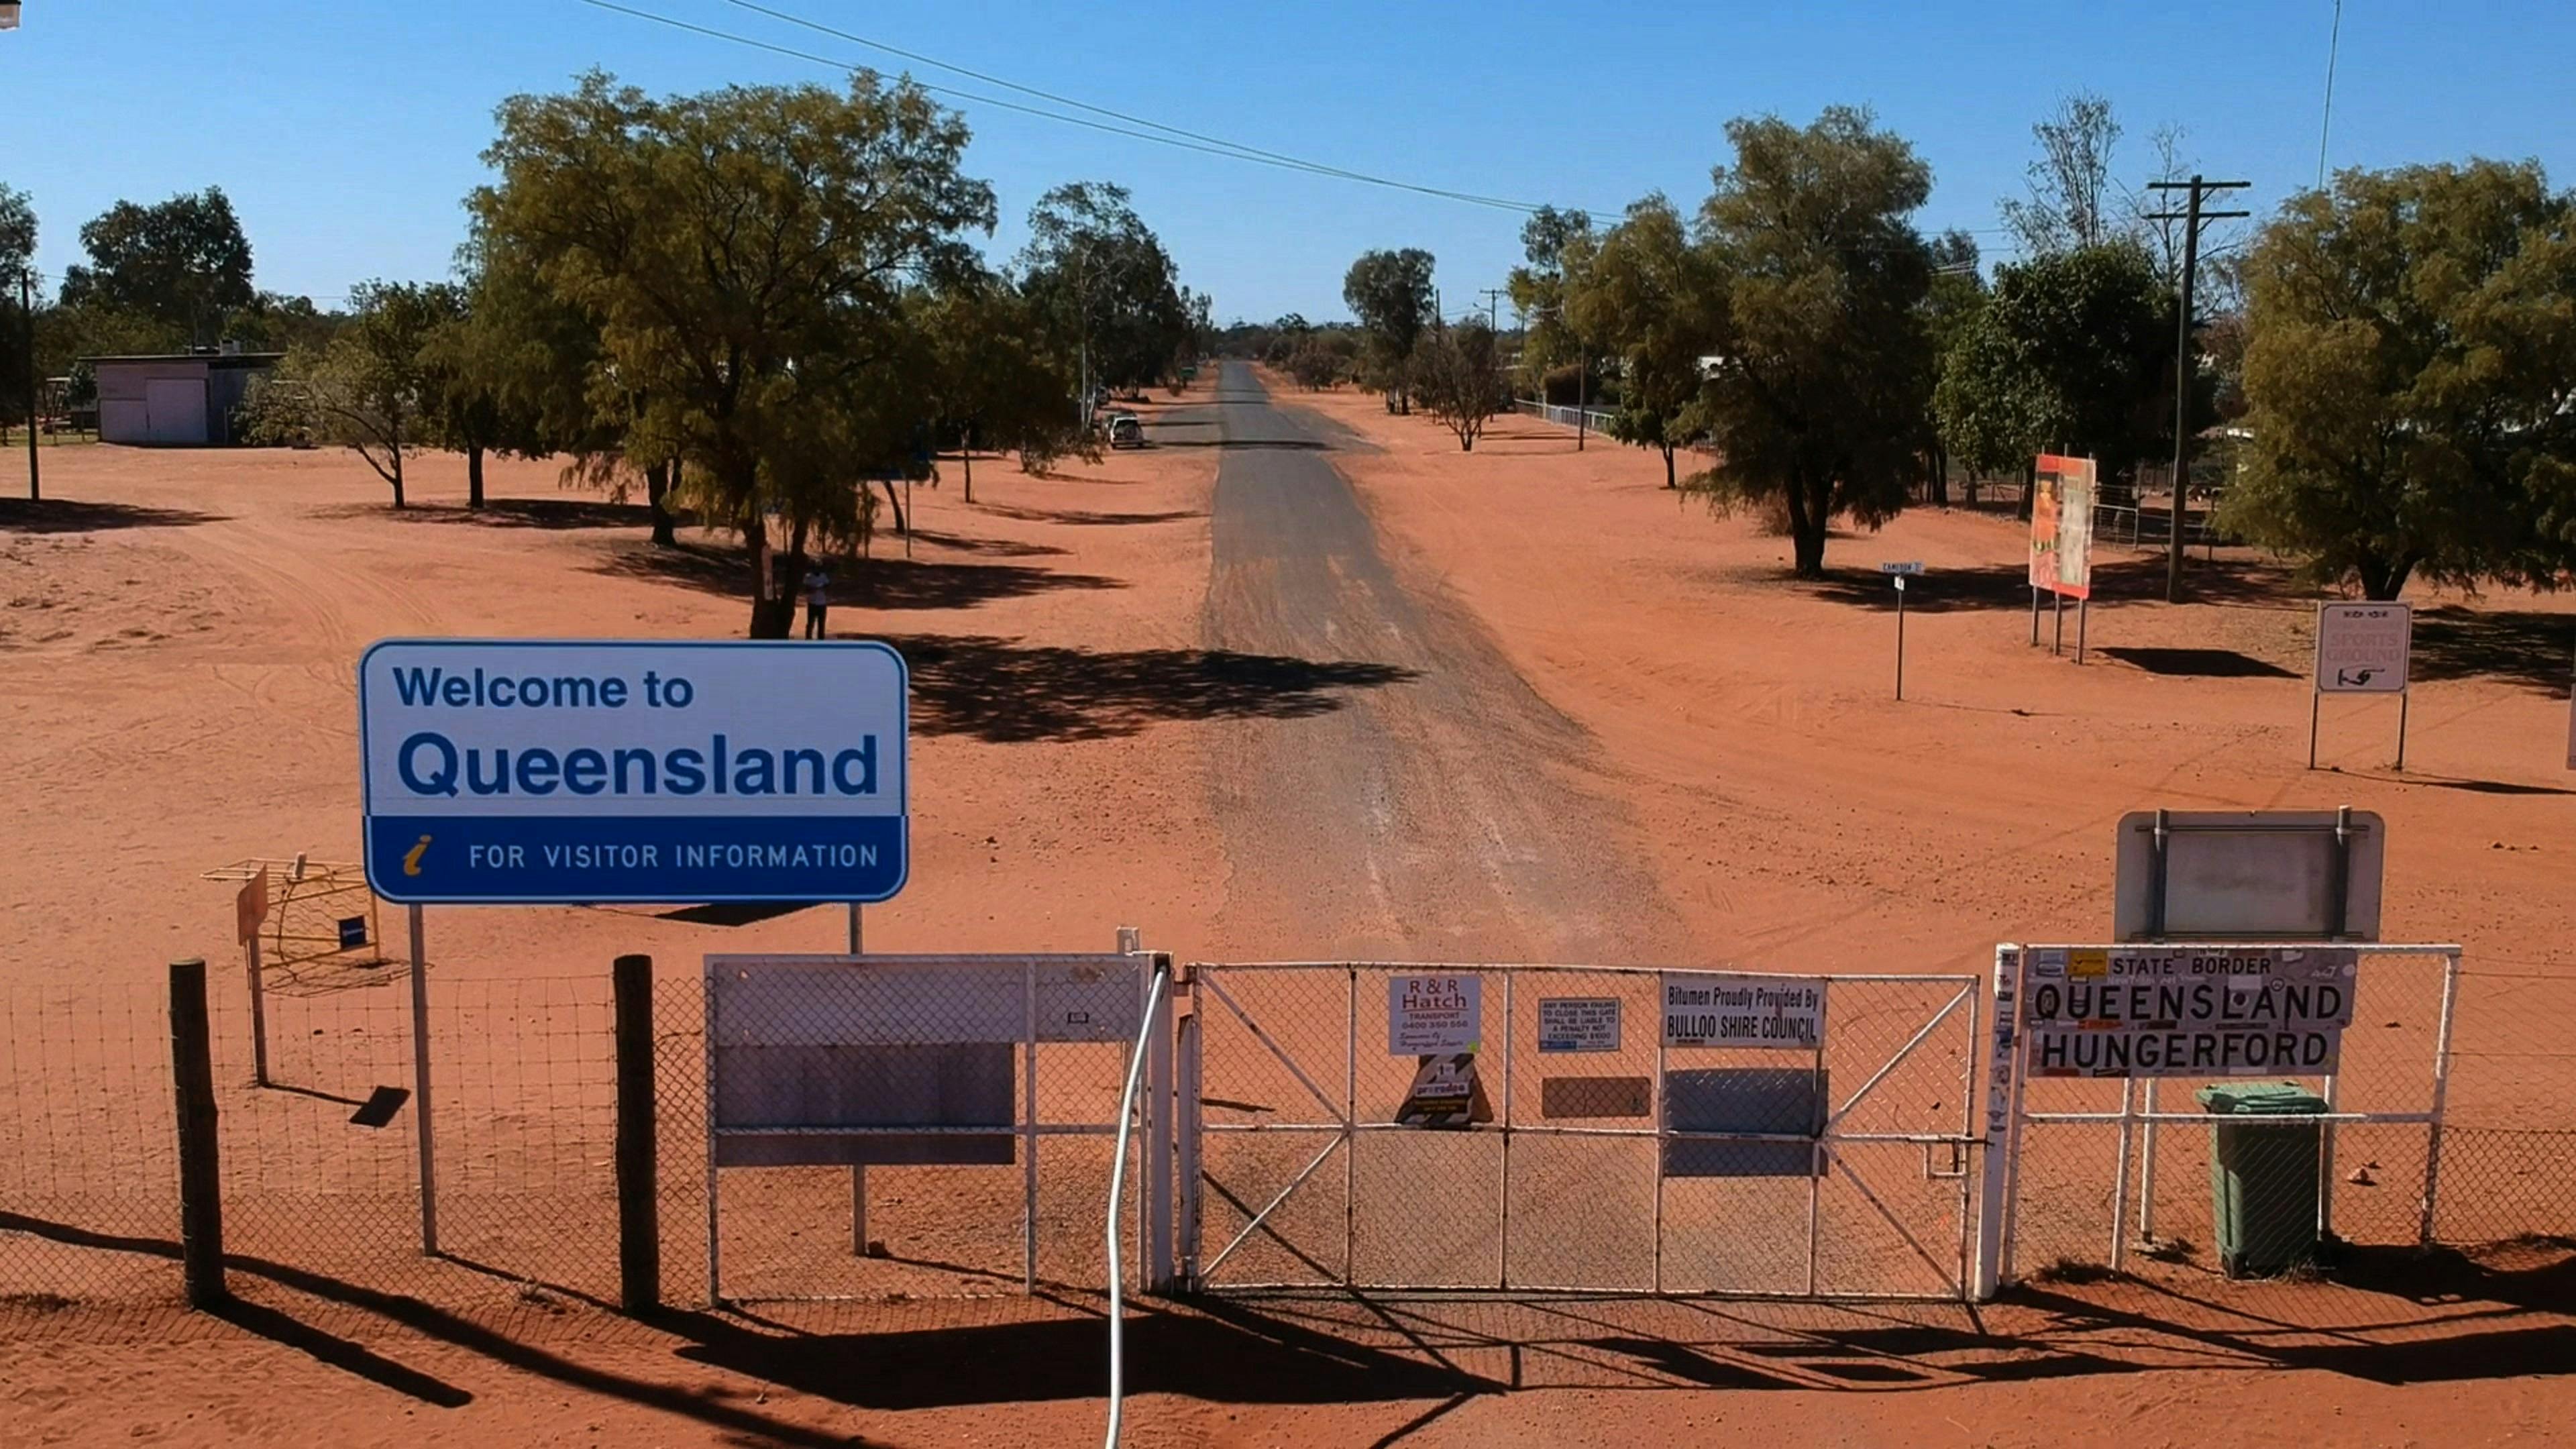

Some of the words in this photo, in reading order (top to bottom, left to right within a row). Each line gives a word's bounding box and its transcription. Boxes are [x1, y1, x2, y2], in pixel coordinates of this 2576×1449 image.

[393, 667, 628, 708] Welcome
[643, 670, 694, 708] to
[398, 732, 877, 798] Queensland
[470, 845, 525, 868] FOR
[544, 845, 658, 868] VISITOR
[676, 845, 877, 867] INFORMATION
[2113, 958, 2175, 975] STATE
[2192, 957, 2271, 974] BORDER
[1409, 980, 1421, 994] R
[1426, 979, 1442, 994] &
[1447, 979, 1458, 992] R
[1668, 985, 1711, 1006] Bitumen
[1713, 986, 1754, 1010] Proudly
[1756, 987, 1803, 1007] Provided
[1805, 988, 1819, 1011] By
[1402, 993, 1467, 1008] Hatch
[2035, 983, 2342, 1020] QUEENSLAND
[1409, 1012, 1460, 1020] TRANSPORT
[1592, 1024, 1607, 1032] NOT
[1667, 1015, 1717, 1038] BULLOO
[1720, 1015, 1758, 1038] SHIRE
[1762, 1016, 1817, 1041] COUNCIL
[2041, 1032, 2328, 1067] HUNGERFORD
